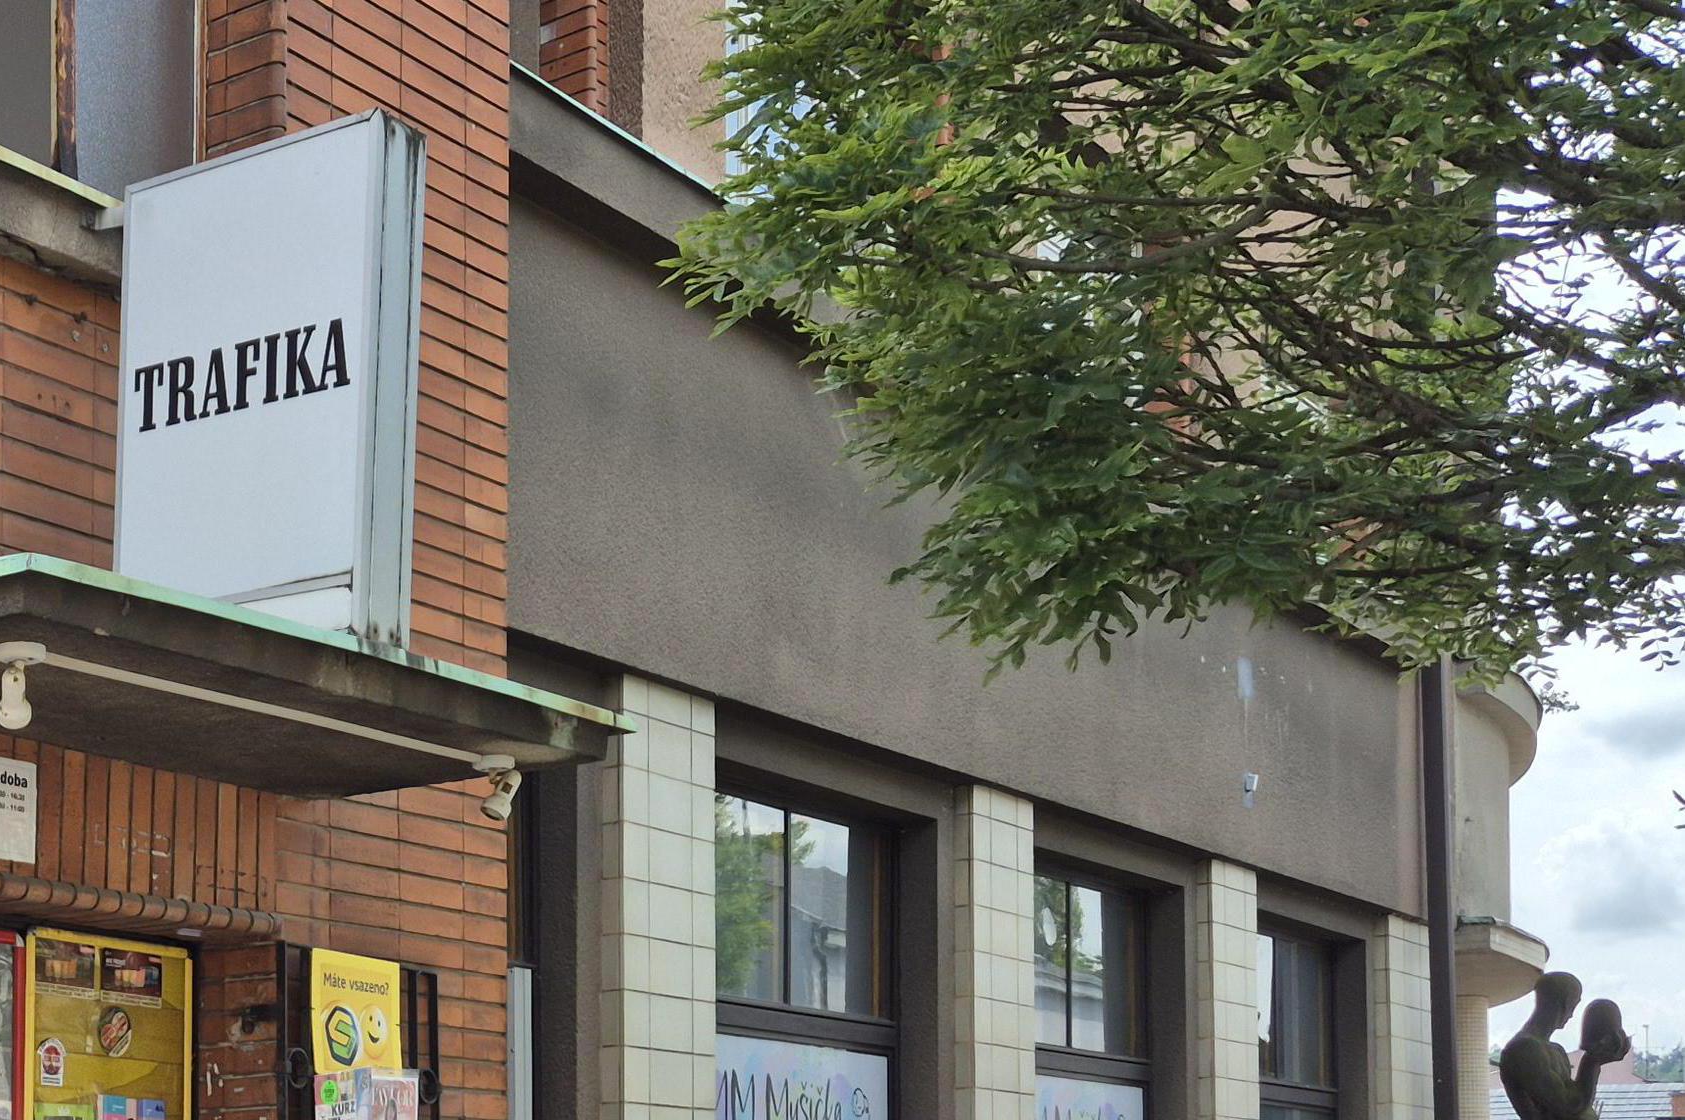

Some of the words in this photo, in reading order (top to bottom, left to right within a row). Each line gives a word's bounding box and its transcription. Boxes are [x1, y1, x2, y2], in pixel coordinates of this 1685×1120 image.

[134, 317, 351, 433] TRAFIKA
[0, 771, 29, 788] doba
[324, 973, 347, 990] Máte
[349, 980, 390, 996] vsazeno?
[332, 1101, 355, 1116] KURZ
